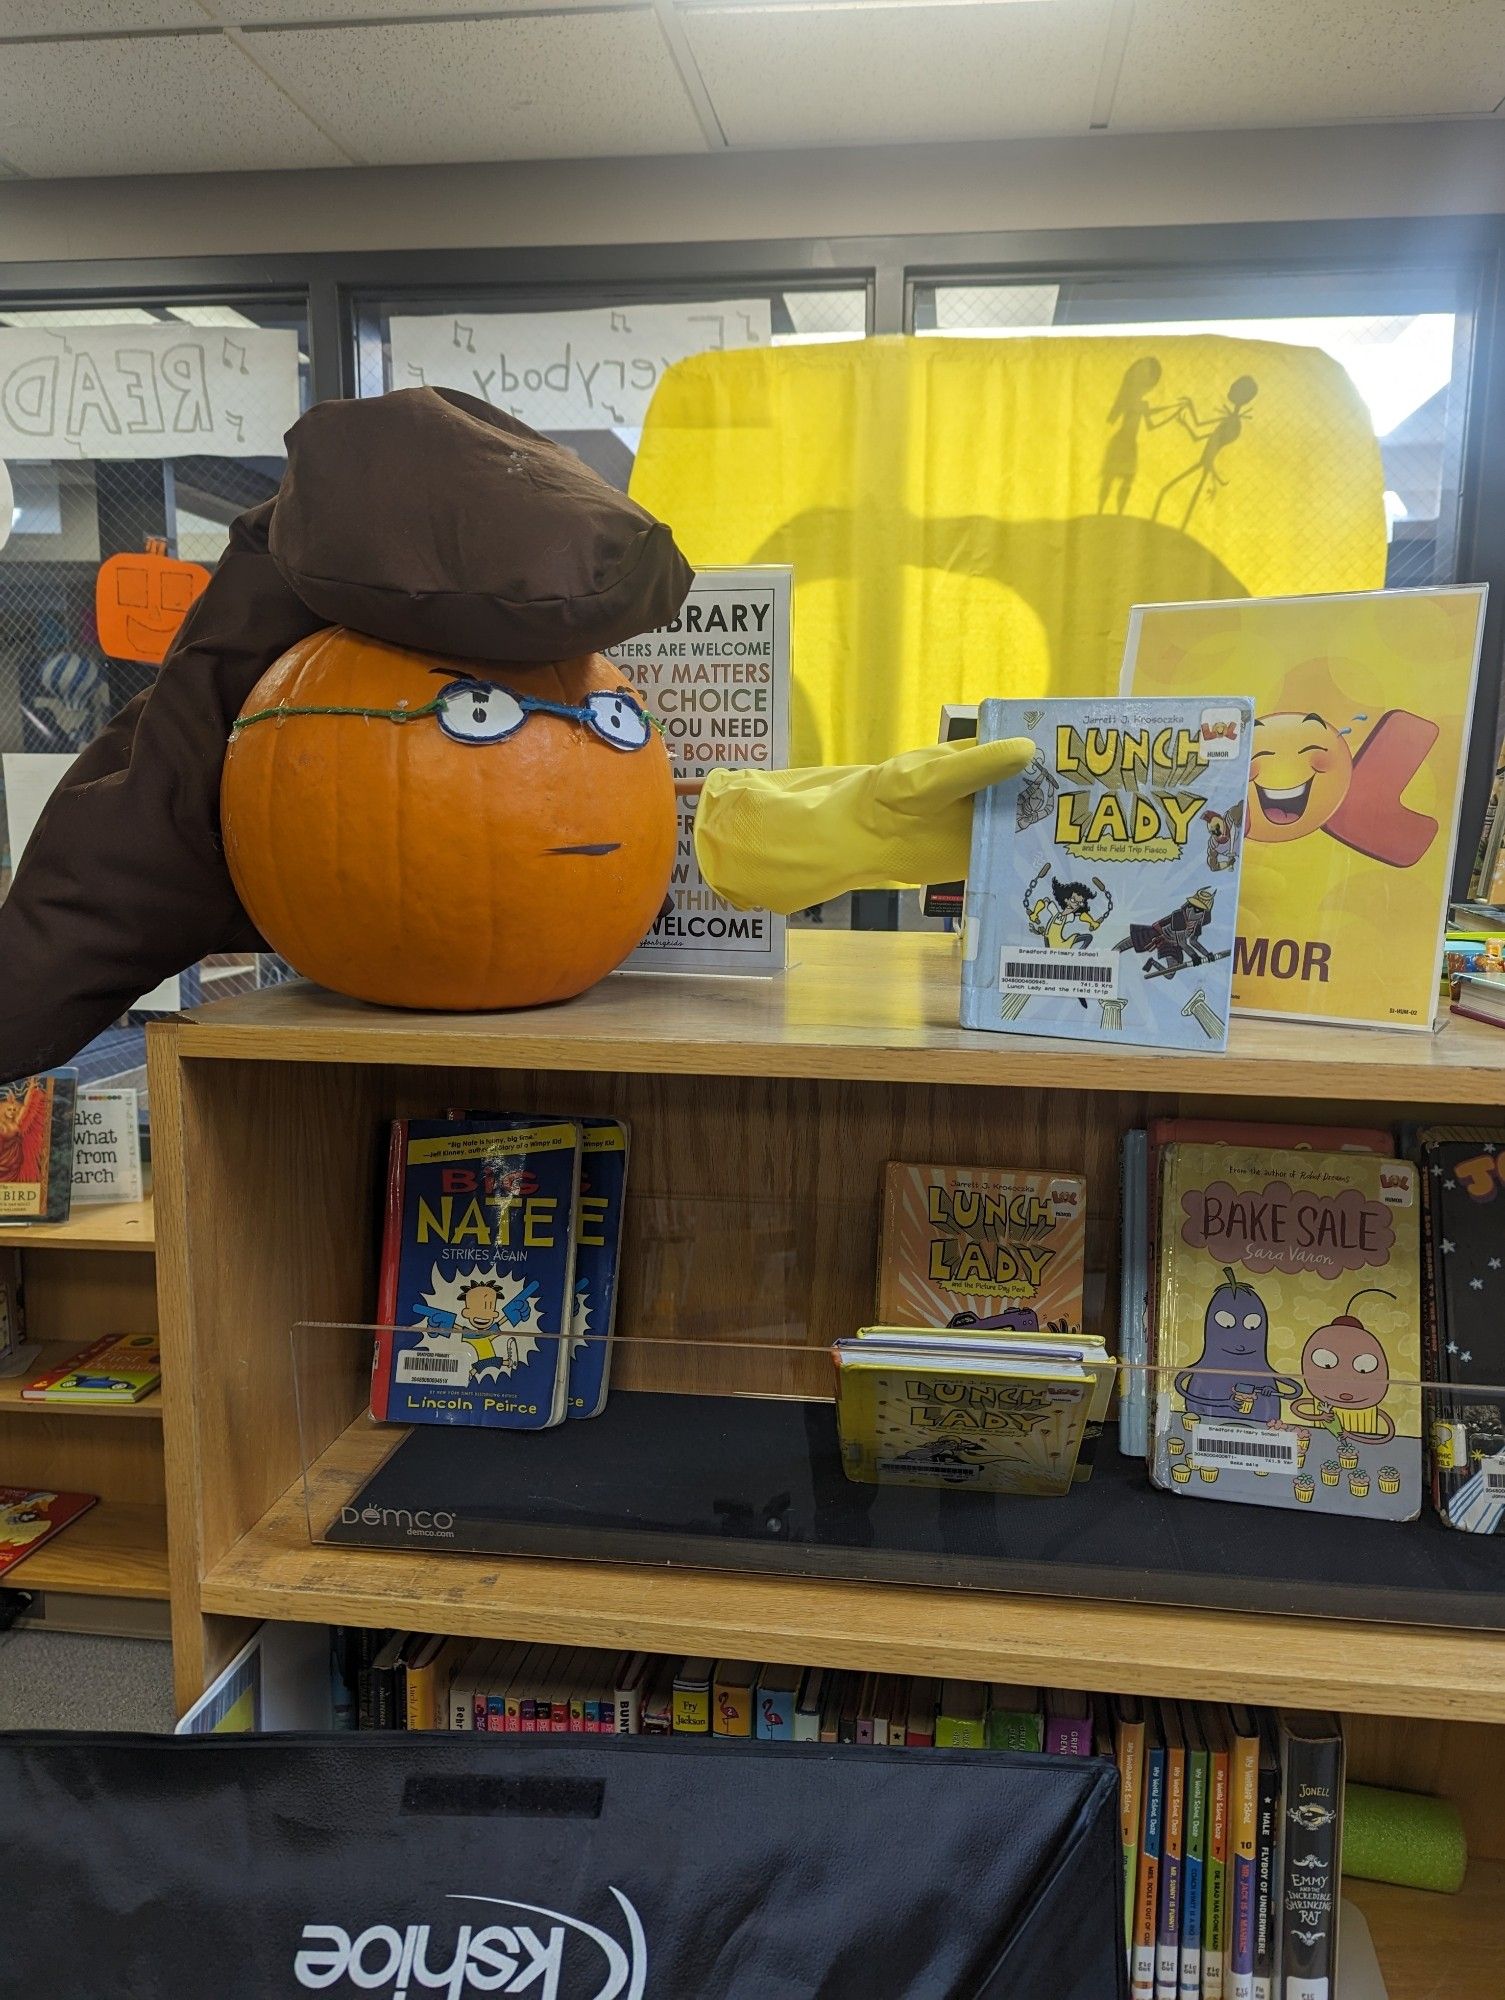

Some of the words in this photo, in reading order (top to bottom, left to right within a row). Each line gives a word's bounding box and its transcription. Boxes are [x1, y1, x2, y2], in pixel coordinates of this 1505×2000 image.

[656, 643, 686, 656] ARE
[691, 641, 771, 656] WELCOME
[671, 662, 770, 684] MATTERS
[657, 688, 767, 712] CHOICE
[711, 718, 769, 737] NEED
[683, 743, 769, 761] BORING
[1055, 725, 1209, 781] LUNCH
[1054, 791, 1207, 845] LADY
[1082, 844, 1094, 852] and
[1096, 844, 1108, 852] the
[1109, 845, 1126, 853] Field
[1128, 846, 1142, 854] Trip
[1144, 846, 1168, 854] Fiasco
[73, 1128, 118, 1145] what
[76, 1150, 117, 1164] from
[1229, 1166, 1247, 1175] From
[1250, 1166, 1261, 1176] the
[1264, 1169, 1288, 1179] author
[1289, 1170, 1297, 1179] of
[3, 1190, 37, 1201] BIRD
[928, 1186, 1057, 1231] LUNCH
[416, 1194, 558, 1248] NATE
[1200, 1196, 1287, 1242] BAKE
[1297, 1205, 1378, 1251] SALE
[441, 1248, 490, 1262] STRIKES
[493, 1249, 528, 1262] AGAIN
[928, 1239, 1057, 1286] LADY
[1244, 1243, 1284, 1261] Sara
[1289, 1246, 1336, 1265] Varon
[975, 1283, 996, 1291] Picture
[905, 1380, 1052, 1407] LUNCH
[407, 1395, 473, 1410] Lincoln
[484, 1398, 537, 1414] Peirce
[910, 1406, 1050, 1432] LADY
[406, 1528, 455, 1538] demco.com
[456, 1706, 465, 1729] Behr
[676, 1713, 705, 1725] Jackson
[1299, 1783, 1330, 1798] JONELL
[1150, 1798, 1158, 1817] School
[1171, 1798, 1179, 1817] School
[1192, 1800, 1200, 1819] School
[1243, 1802, 1252, 1824] School
[1262, 1812, 1271, 1836] HALE
[1240, 1841, 1252, 1849] 10
[1240, 1864, 1249, 1880] MR.
[1260, 1846, 1269, 1879] FLYBOY
[1169, 1880, 1177, 1899] SUNNY
[1240, 1881, 1248, 1900] JACK
[1259, 1880, 1268, 1893] OF
[1290, 1873, 1328, 1889] EMMY
[1285, 1898, 1332, 1911] SHRINKING
[1288, 1891, 1332, 1901] INCREDIBLE
[1240, 1902, 1248, 1911] IS
[1144, 1922, 1151, 1931] OF
[1168, 1908, 1176, 1931] FUNNY!
[1258, 1894, 1268, 1954] UNDERWHERE
[1298, 1910, 1322, 1926] RAT
[294, 1924, 565, 2000] kshioe
